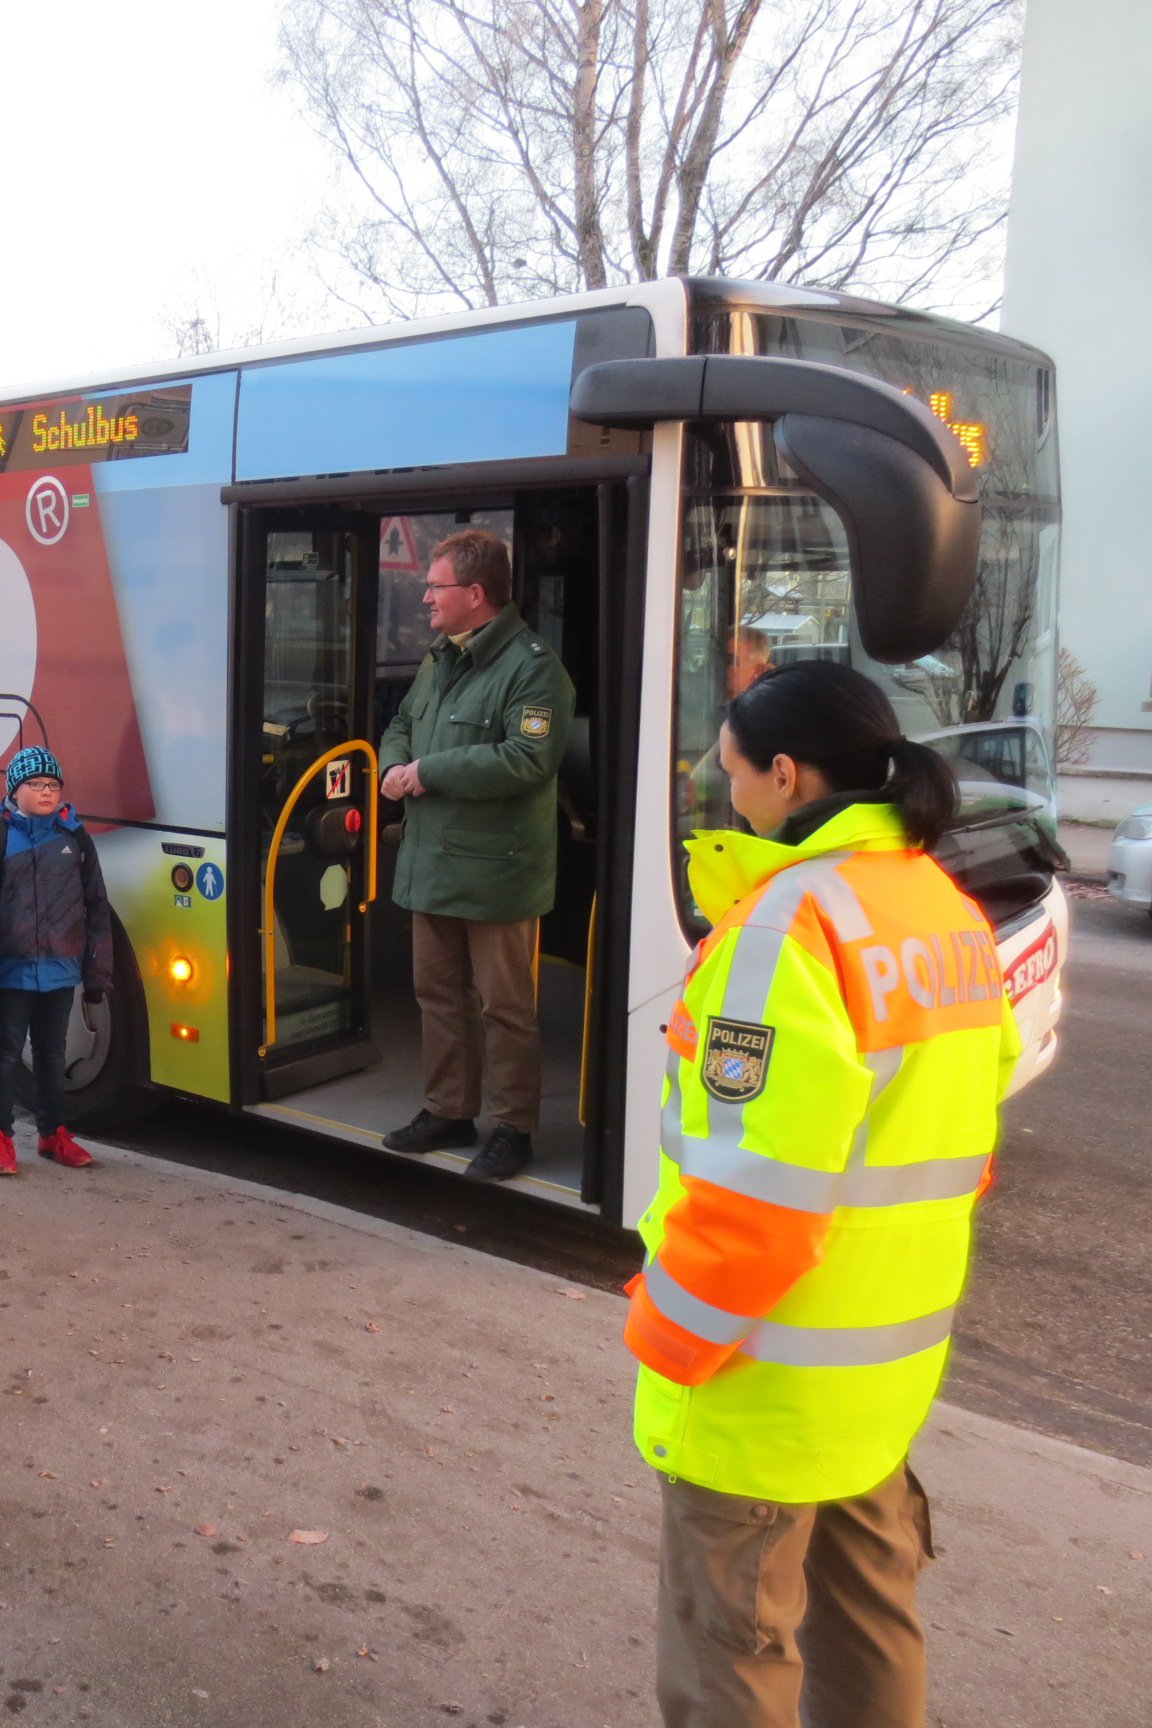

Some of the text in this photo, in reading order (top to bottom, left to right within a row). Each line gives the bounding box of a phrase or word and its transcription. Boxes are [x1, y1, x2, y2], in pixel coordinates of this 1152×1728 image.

[32, 405, 138, 452] Schulbus
[524, 709, 550, 718] POLIZEI
[712, 1027, 766, 1050] POLIZEI
